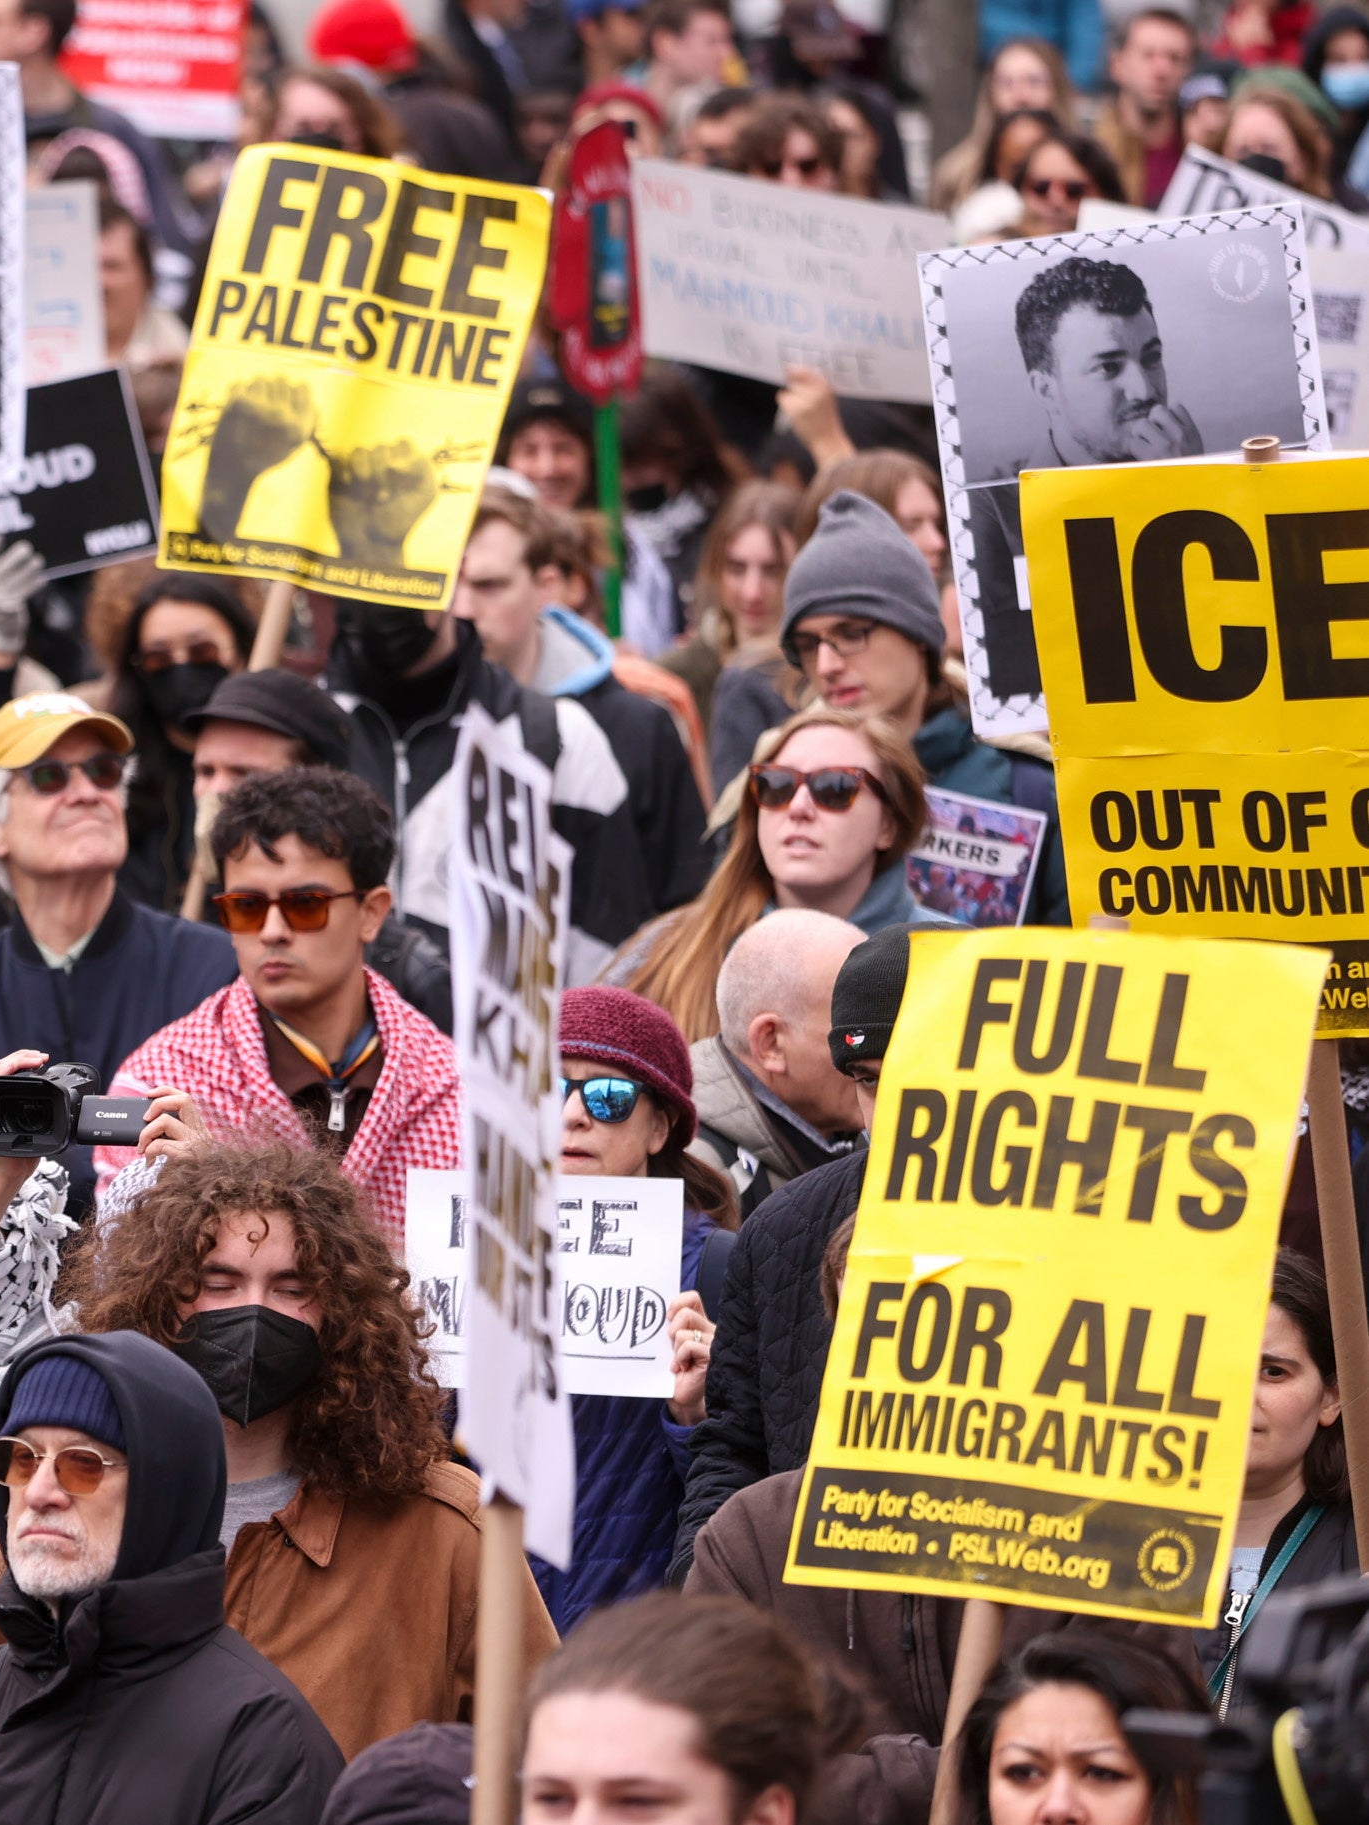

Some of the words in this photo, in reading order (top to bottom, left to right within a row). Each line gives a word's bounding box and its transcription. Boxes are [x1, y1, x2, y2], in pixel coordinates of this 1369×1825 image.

[241, 158, 517, 319] FREE
[640, 176, 692, 218] NO
[711, 186, 869, 258] BUSINESS
[209, 279, 510, 389] PALESTINE
[1063, 508, 1369, 704] ICE
[1090, 790, 1221, 853] OUT
[1241, 790, 1328, 854] OF
[956, 958, 1207, 1093] FULL
[95, 1111, 128, 1119] Canon
[883, 1088, 1257, 1233] RIGHTS
[850, 1280, 1014, 1390] FOR
[1033, 1299, 1222, 1420] ALL
[838, 1390, 1210, 1491] IMMIGRANTS!
[814, 1519, 919, 1555] Liberation
[948, 1531, 1112, 1590] PSLWeb.org
[821, 1485, 877, 1522] Party
[878, 1488, 909, 1518] for
[909, 1491, 1025, 1533] Socialism
[1027, 1512, 1085, 1543] and
